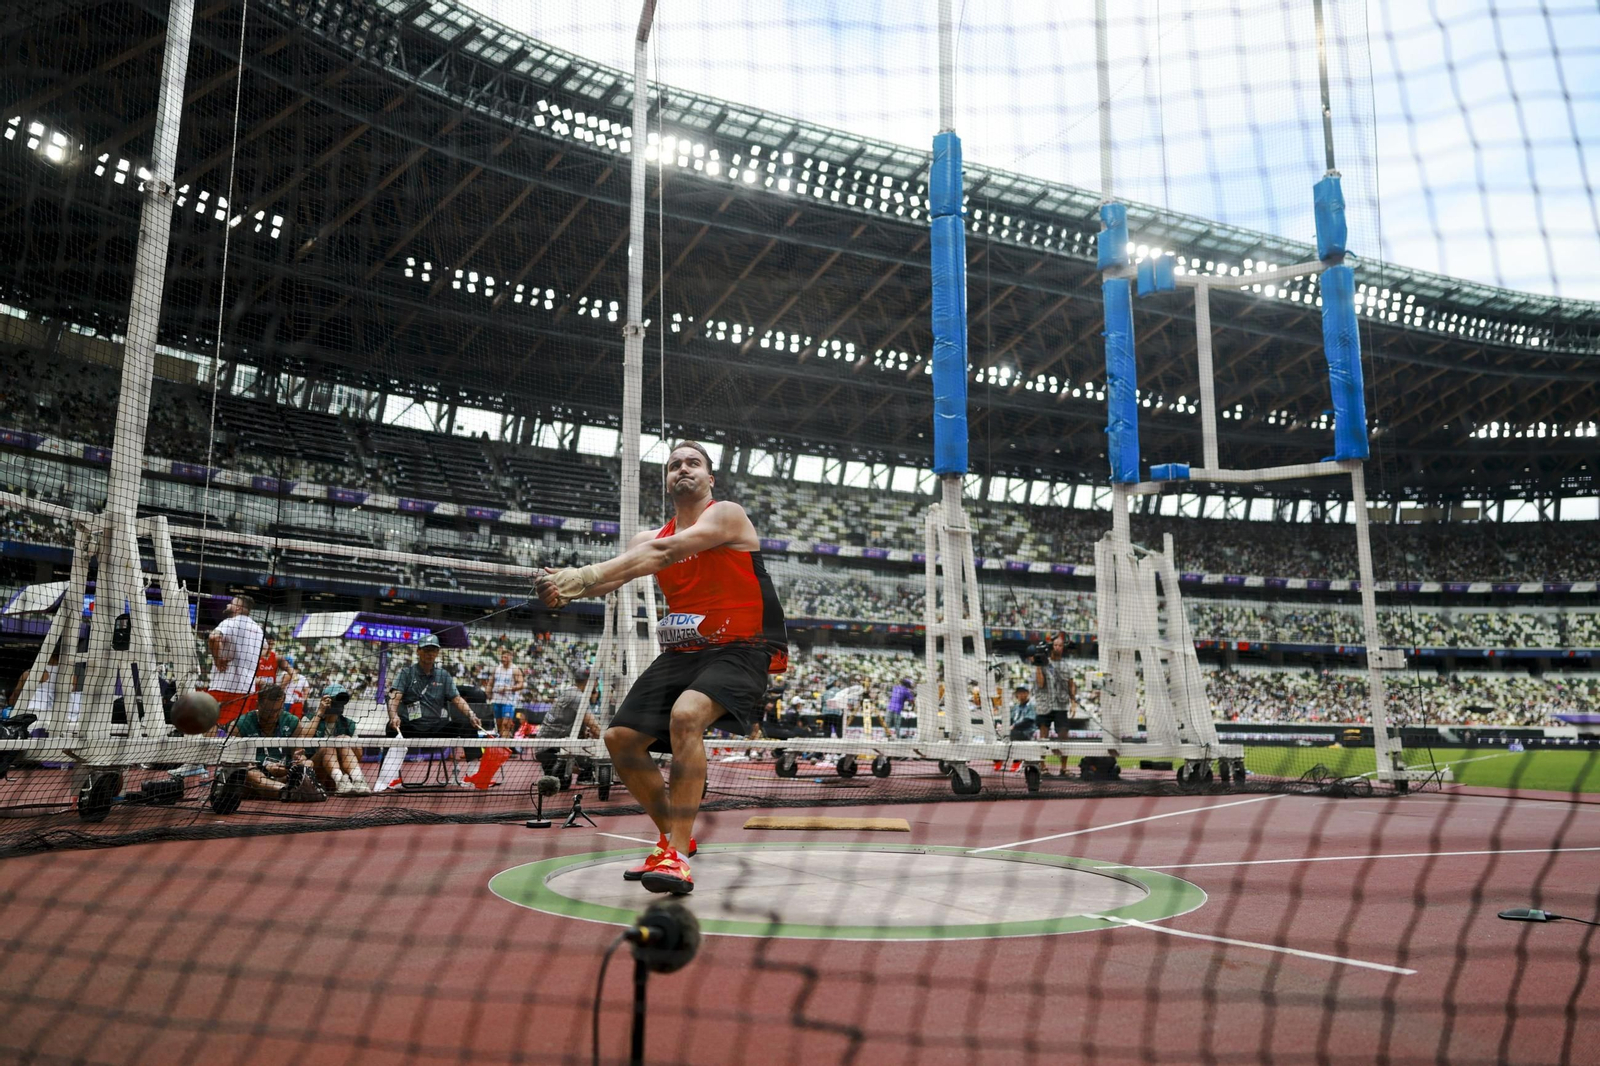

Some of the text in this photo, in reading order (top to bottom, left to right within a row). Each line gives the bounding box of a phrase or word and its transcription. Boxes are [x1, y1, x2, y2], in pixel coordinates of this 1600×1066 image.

[669, 614, 700, 625] TDK
[368, 628, 410, 638] TOKYO
[658, 628, 700, 642] YILMAZER
